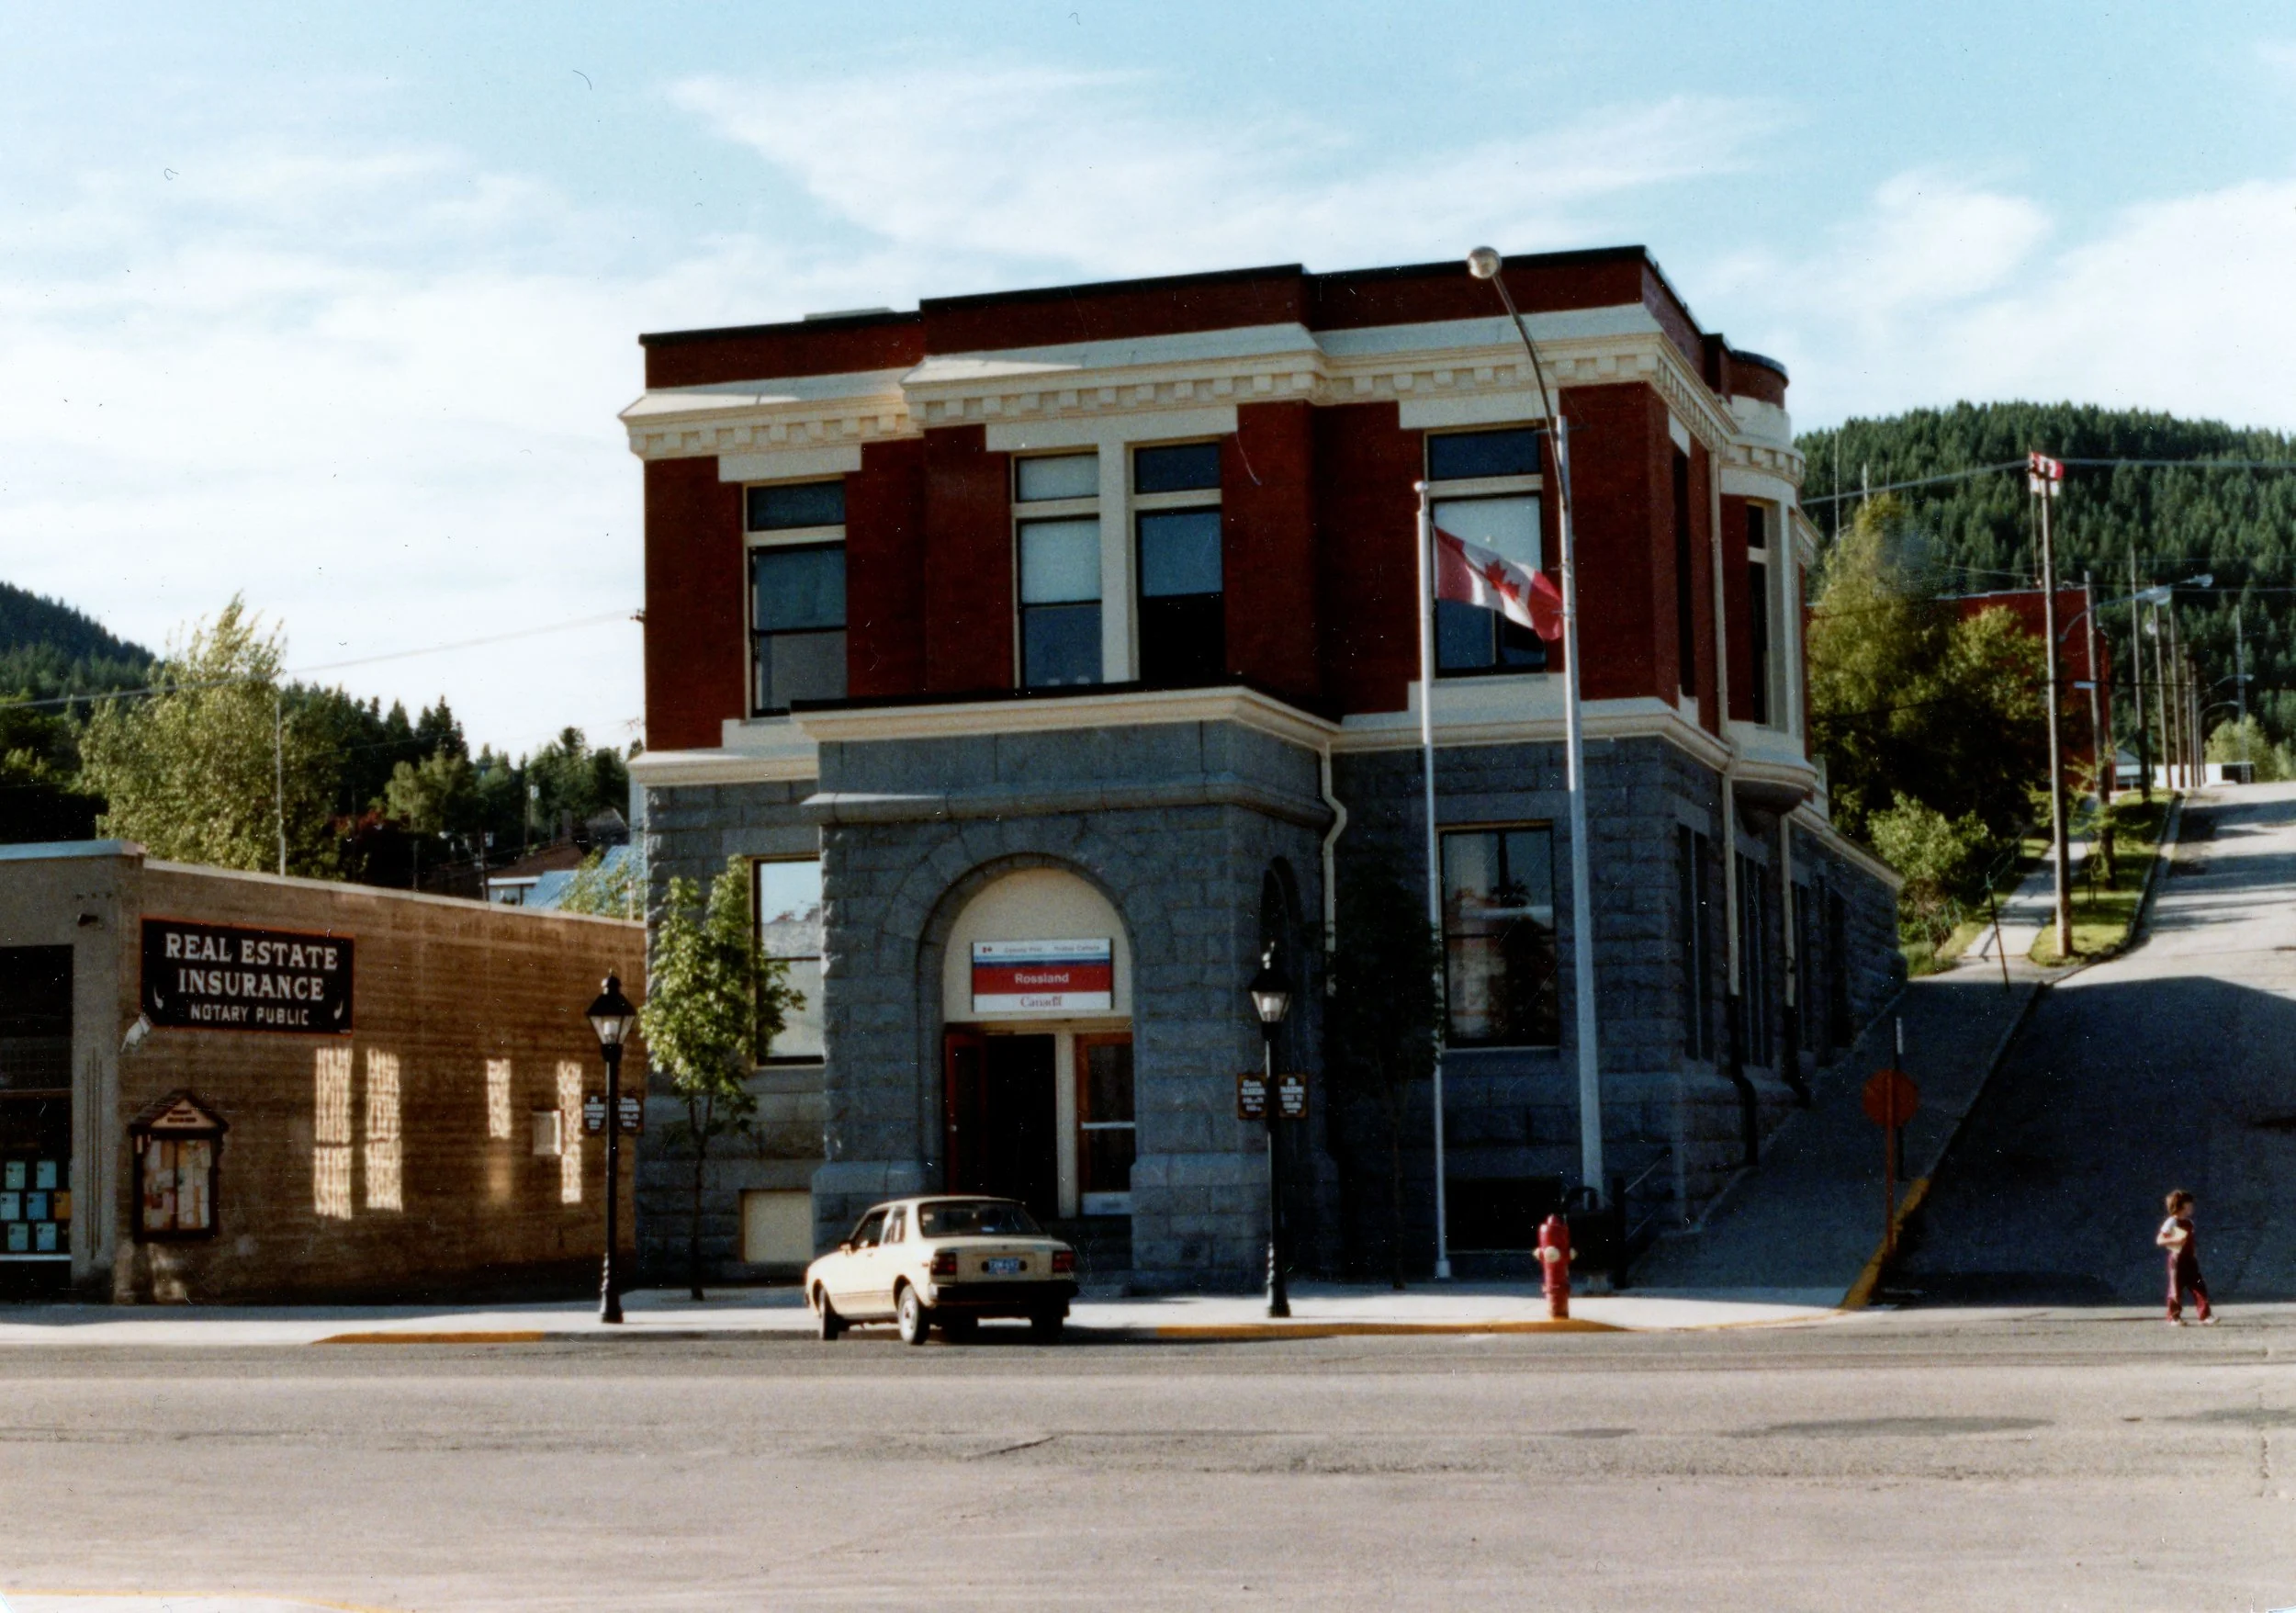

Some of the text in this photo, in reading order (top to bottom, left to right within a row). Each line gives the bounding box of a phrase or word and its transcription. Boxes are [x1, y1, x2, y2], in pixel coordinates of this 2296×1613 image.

[165, 932, 338, 971] REAL ESTATE
[178, 968, 324, 1001] INSURANCE
[1015, 972, 1070, 985] Rossland
[190, 1003, 310, 1025] NOTARY PUBLIC
